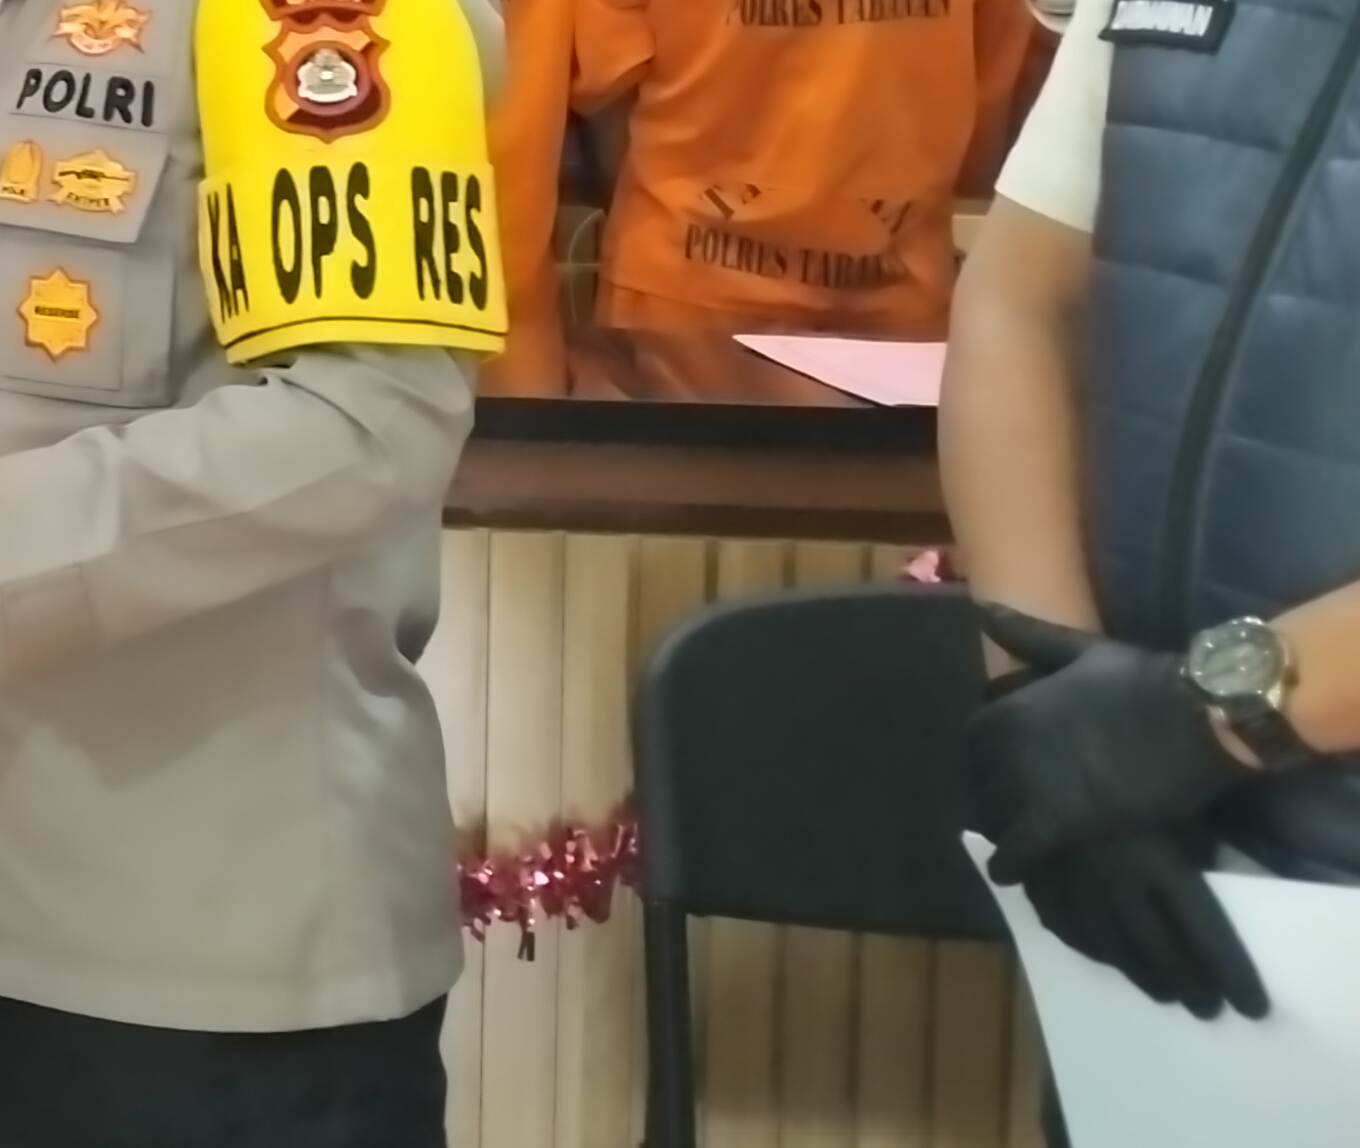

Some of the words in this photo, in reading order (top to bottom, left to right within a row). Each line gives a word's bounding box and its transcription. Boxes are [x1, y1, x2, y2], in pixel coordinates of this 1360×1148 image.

[16, 68, 155, 128] POLRI
[207, 182, 250, 325] KA
[271, 162, 377, 305] OPS
[411, 166, 488, 312] RES
